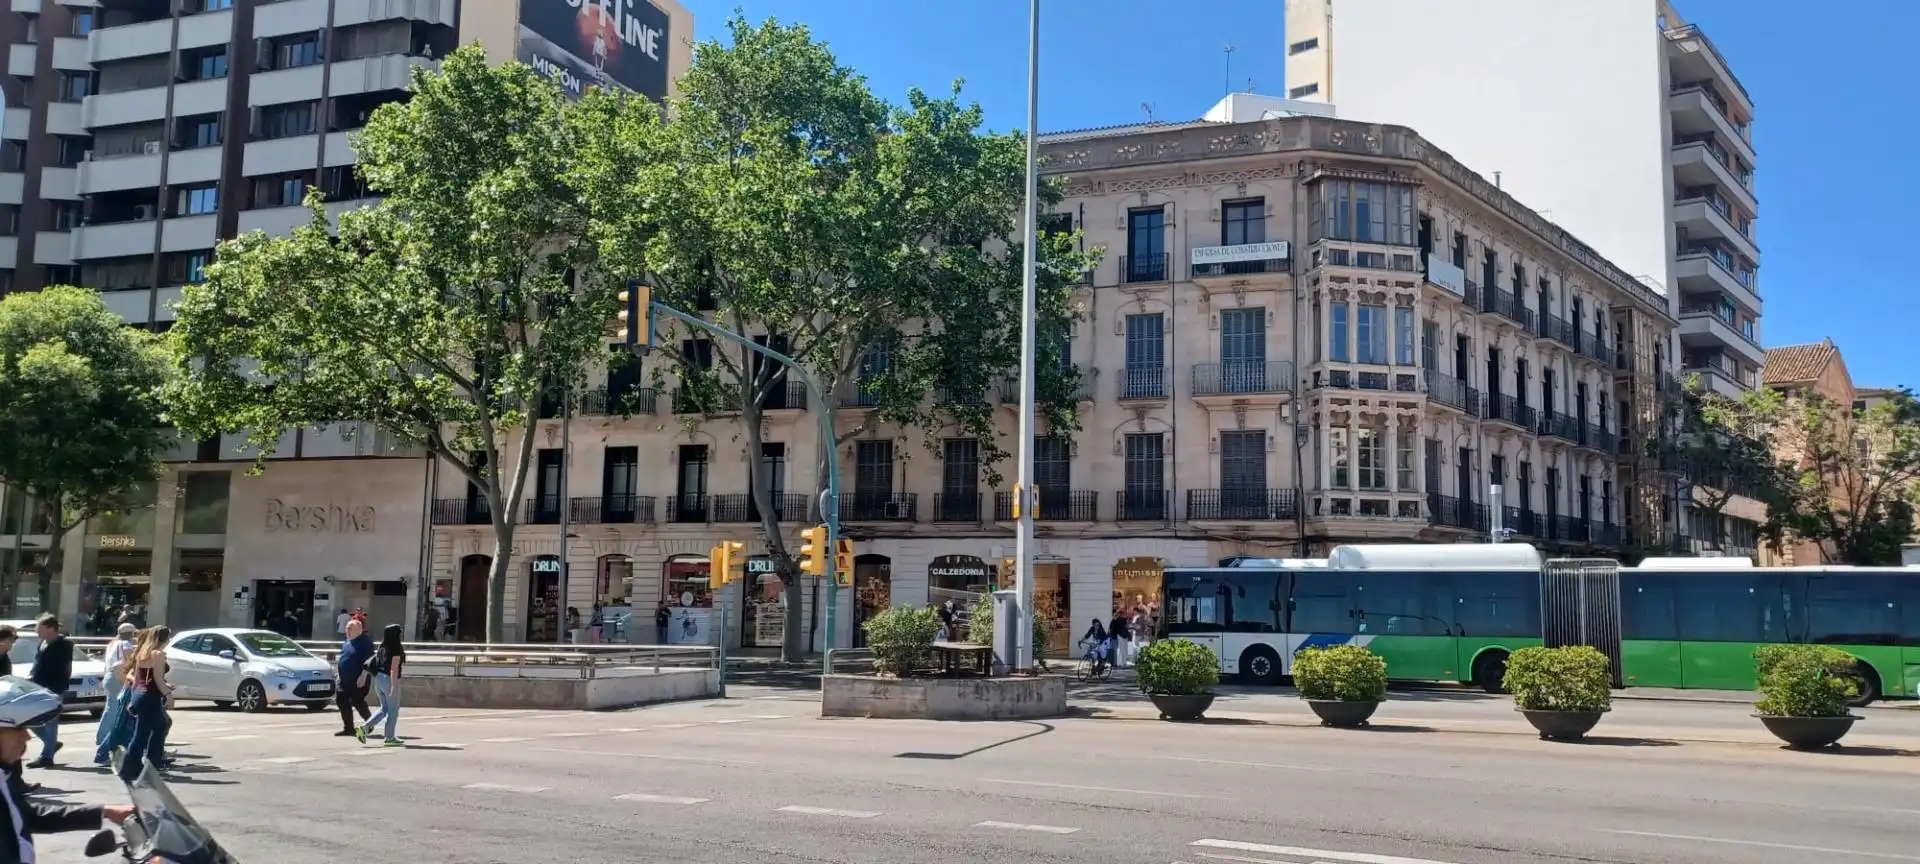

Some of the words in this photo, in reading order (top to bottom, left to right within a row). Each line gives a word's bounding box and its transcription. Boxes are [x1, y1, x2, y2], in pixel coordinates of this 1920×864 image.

[532, 53, 580, 93] MISÓN
[264, 497, 375, 532] Bershka
[100, 535, 136, 548] Bershka
[932, 567, 985, 576] CALZEDONIA
